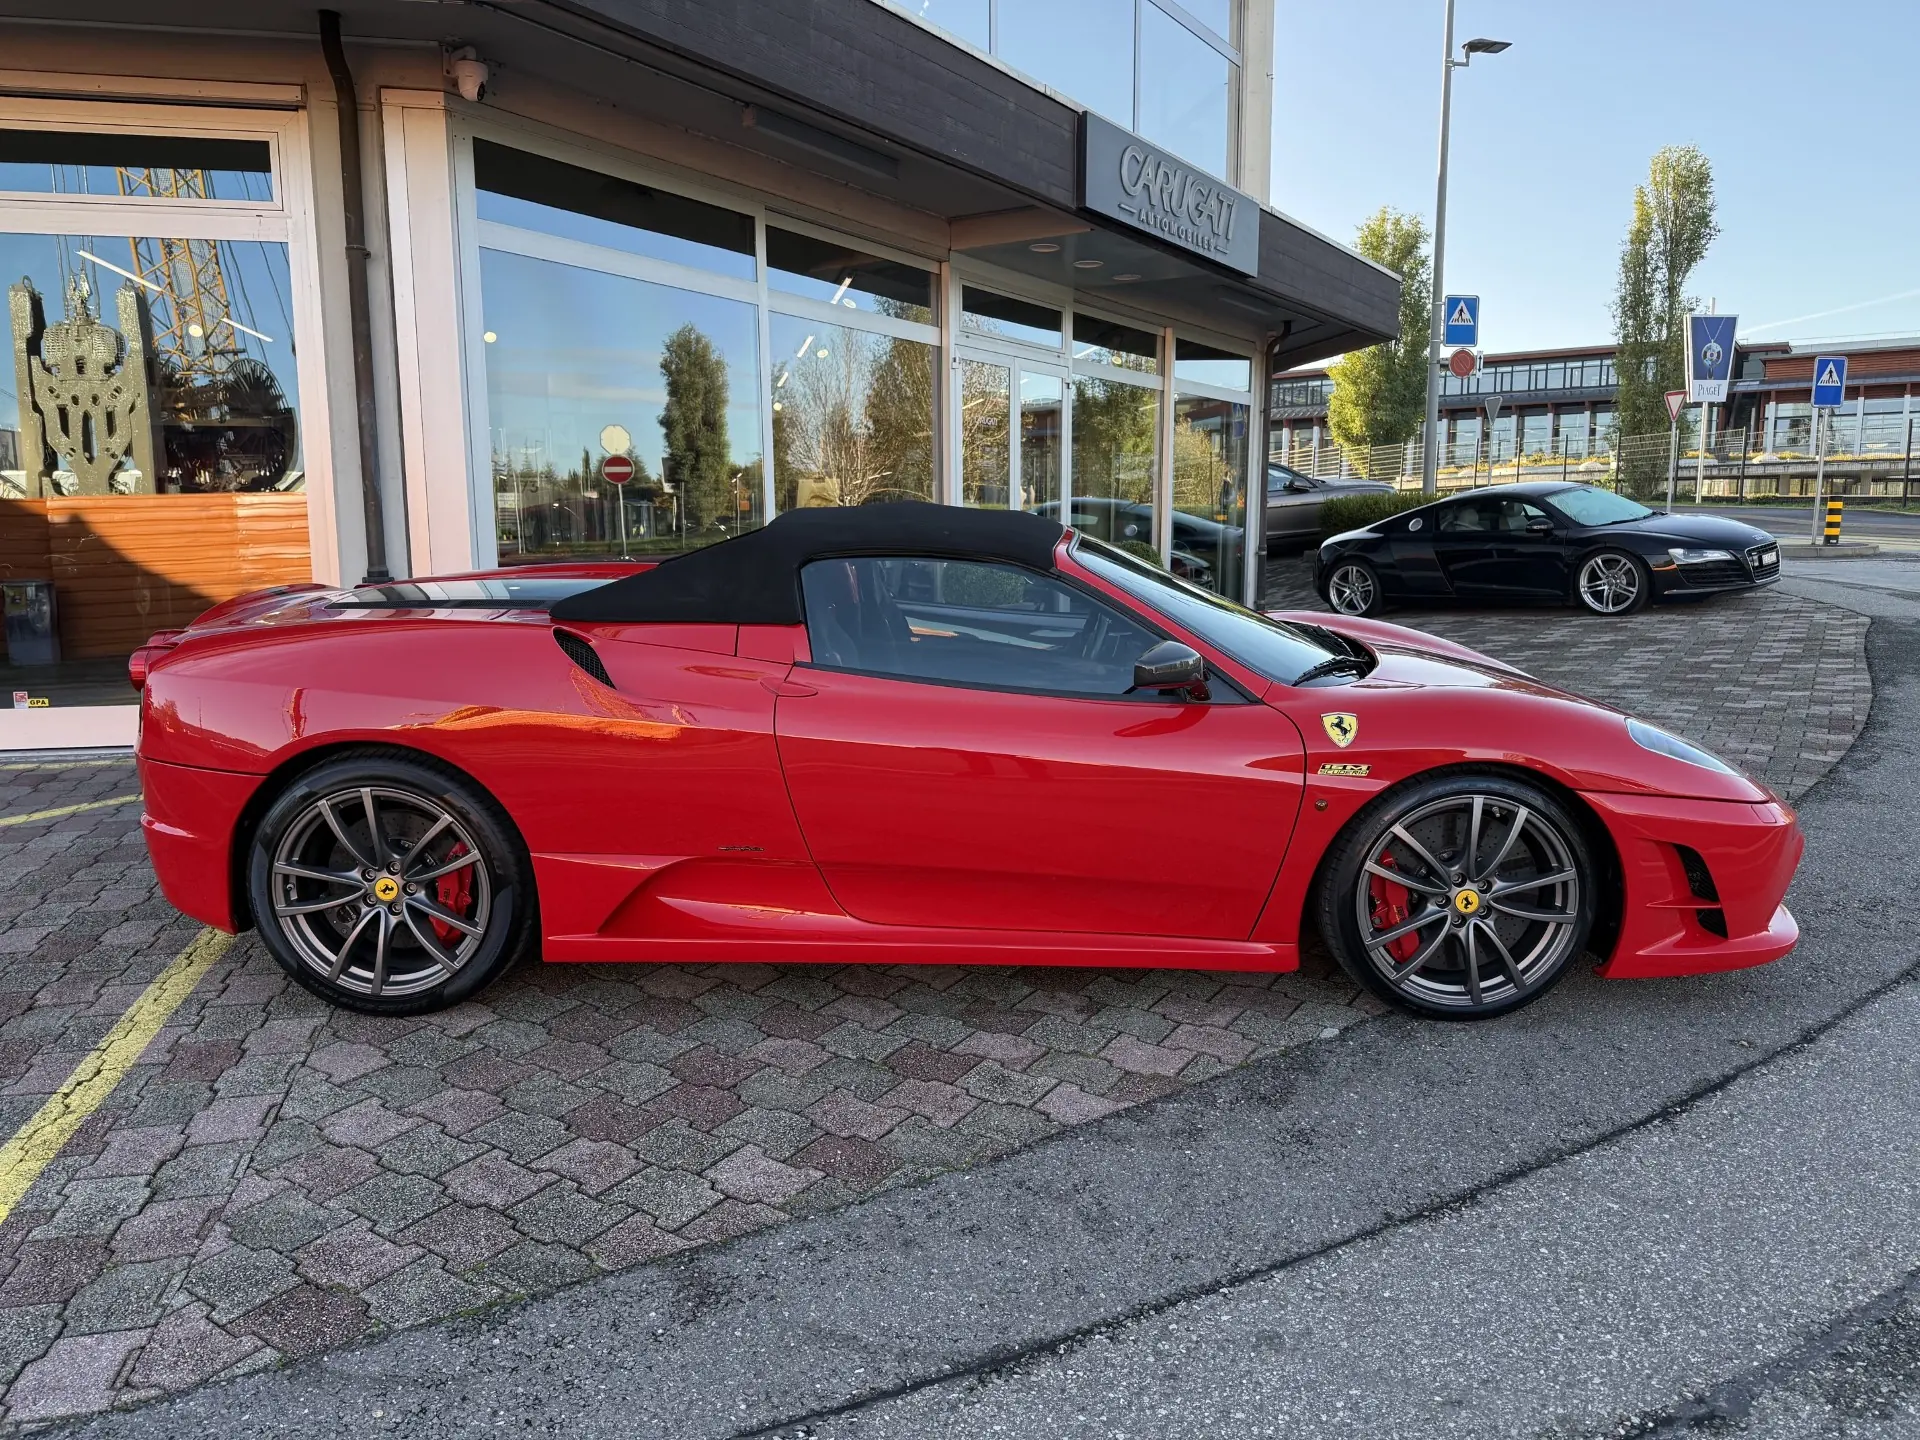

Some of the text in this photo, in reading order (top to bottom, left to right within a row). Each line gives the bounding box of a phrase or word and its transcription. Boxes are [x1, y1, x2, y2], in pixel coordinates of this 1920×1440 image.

[1120, 145, 1237, 240] CARUGATI
[1138, 208, 1215, 252] AUTOMOBILES
[1697, 384, 1722, 397] PIAGET
